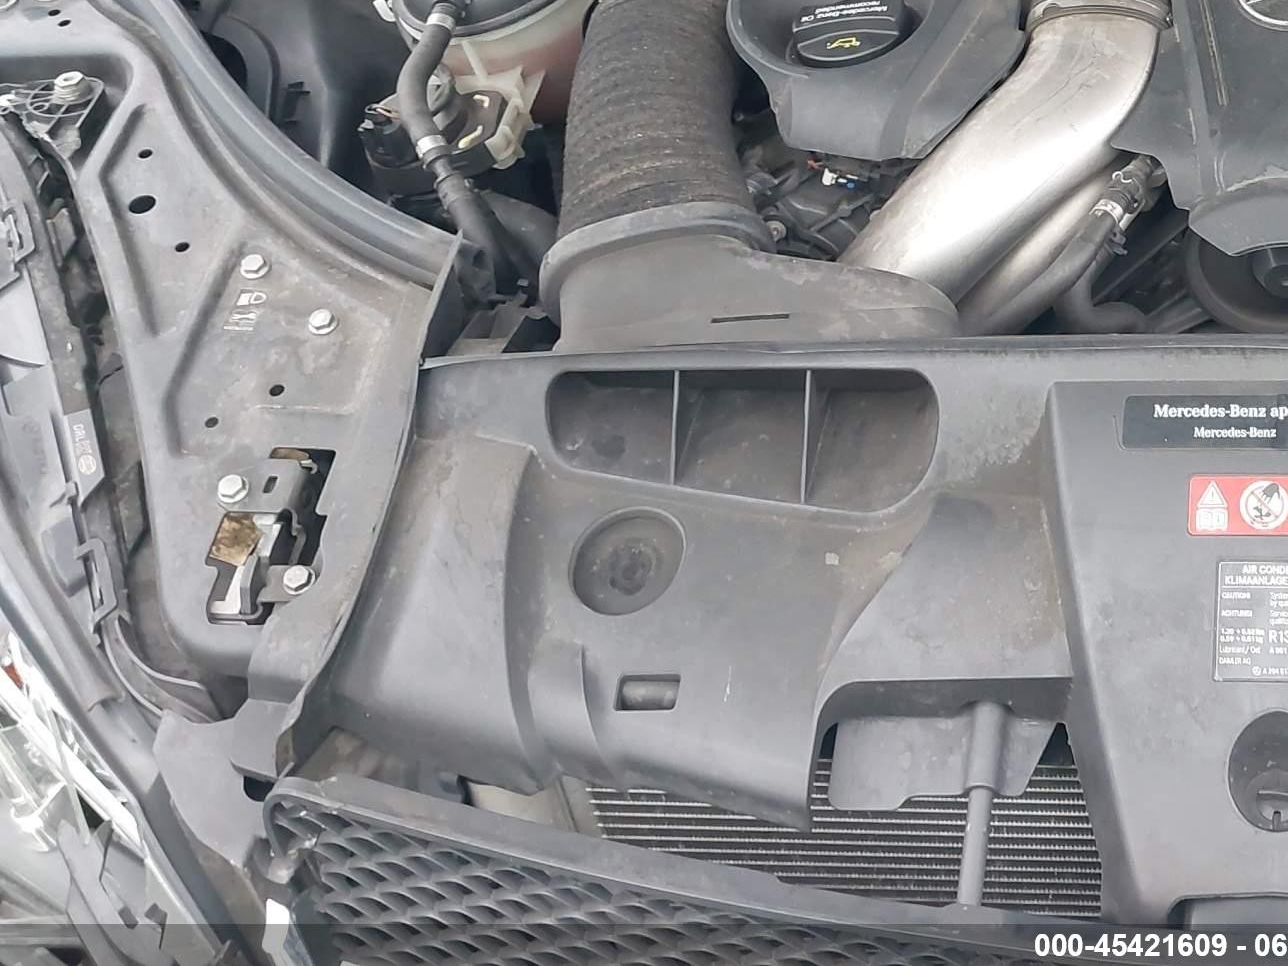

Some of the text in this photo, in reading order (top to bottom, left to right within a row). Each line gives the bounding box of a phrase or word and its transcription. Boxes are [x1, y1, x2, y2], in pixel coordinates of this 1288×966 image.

[1153, 404, 1266, 418] Mercedes-Benz
[1193, 426, 1277, 439] Mercedes-Benz
[1242, 565, 1257, 575] AIR
[1224, 575, 1288, 586] KLIMAANLAGE
